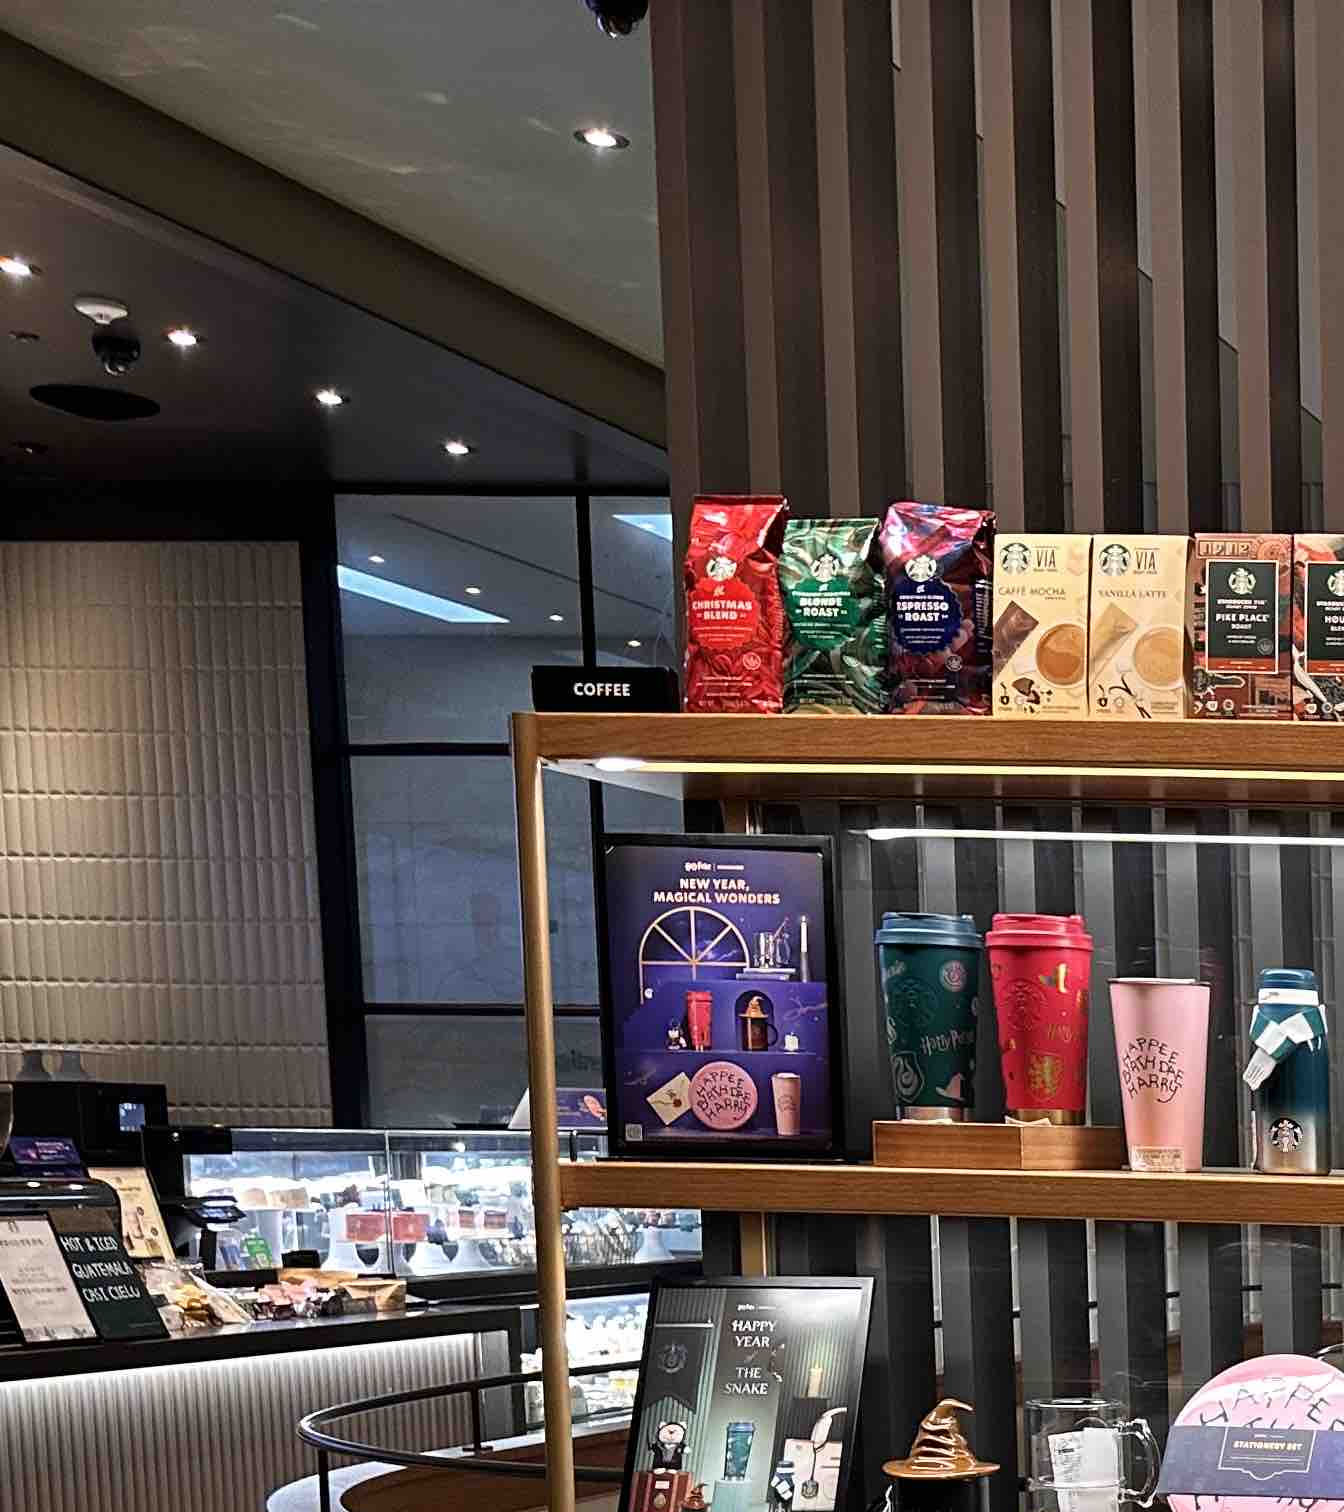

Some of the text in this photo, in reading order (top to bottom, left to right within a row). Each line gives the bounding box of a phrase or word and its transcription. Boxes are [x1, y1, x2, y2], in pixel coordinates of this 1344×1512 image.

[1035, 549, 1057, 569] VIA
[1135, 552, 1157, 571] VIA
[1030, 587, 1066, 597] MOCHA
[692, 600, 753, 611] CHRISTMAS
[799, 597, 843, 607] BLONDE
[703, 610, 738, 621] BLEND
[803, 607, 839, 617] ROAST
[904, 612, 941, 622] ROAST
[1215, 613, 1237, 623] PIKE
[573, 682, 631, 697] COFFEE
[679, 878, 750, 892] NEW YEAR,
[653, 891, 781, 905] MAGICAL WONDERS
[1127, 1073, 1180, 1104] HARRY
[59, 1236, 84, 1252] HOT
[94, 1235, 118, 1251] ICED
[71, 1260, 134, 1279] GUATEMALA
[732, 1319, 777, 1332] HAPPY
[735, 1335, 771, 1348] YEAR
[735, 1367, 762, 1379] THE
[724, 1383, 769, 1395] SNAKE
[1233, 1440, 1286, 1451] STATIONERY
